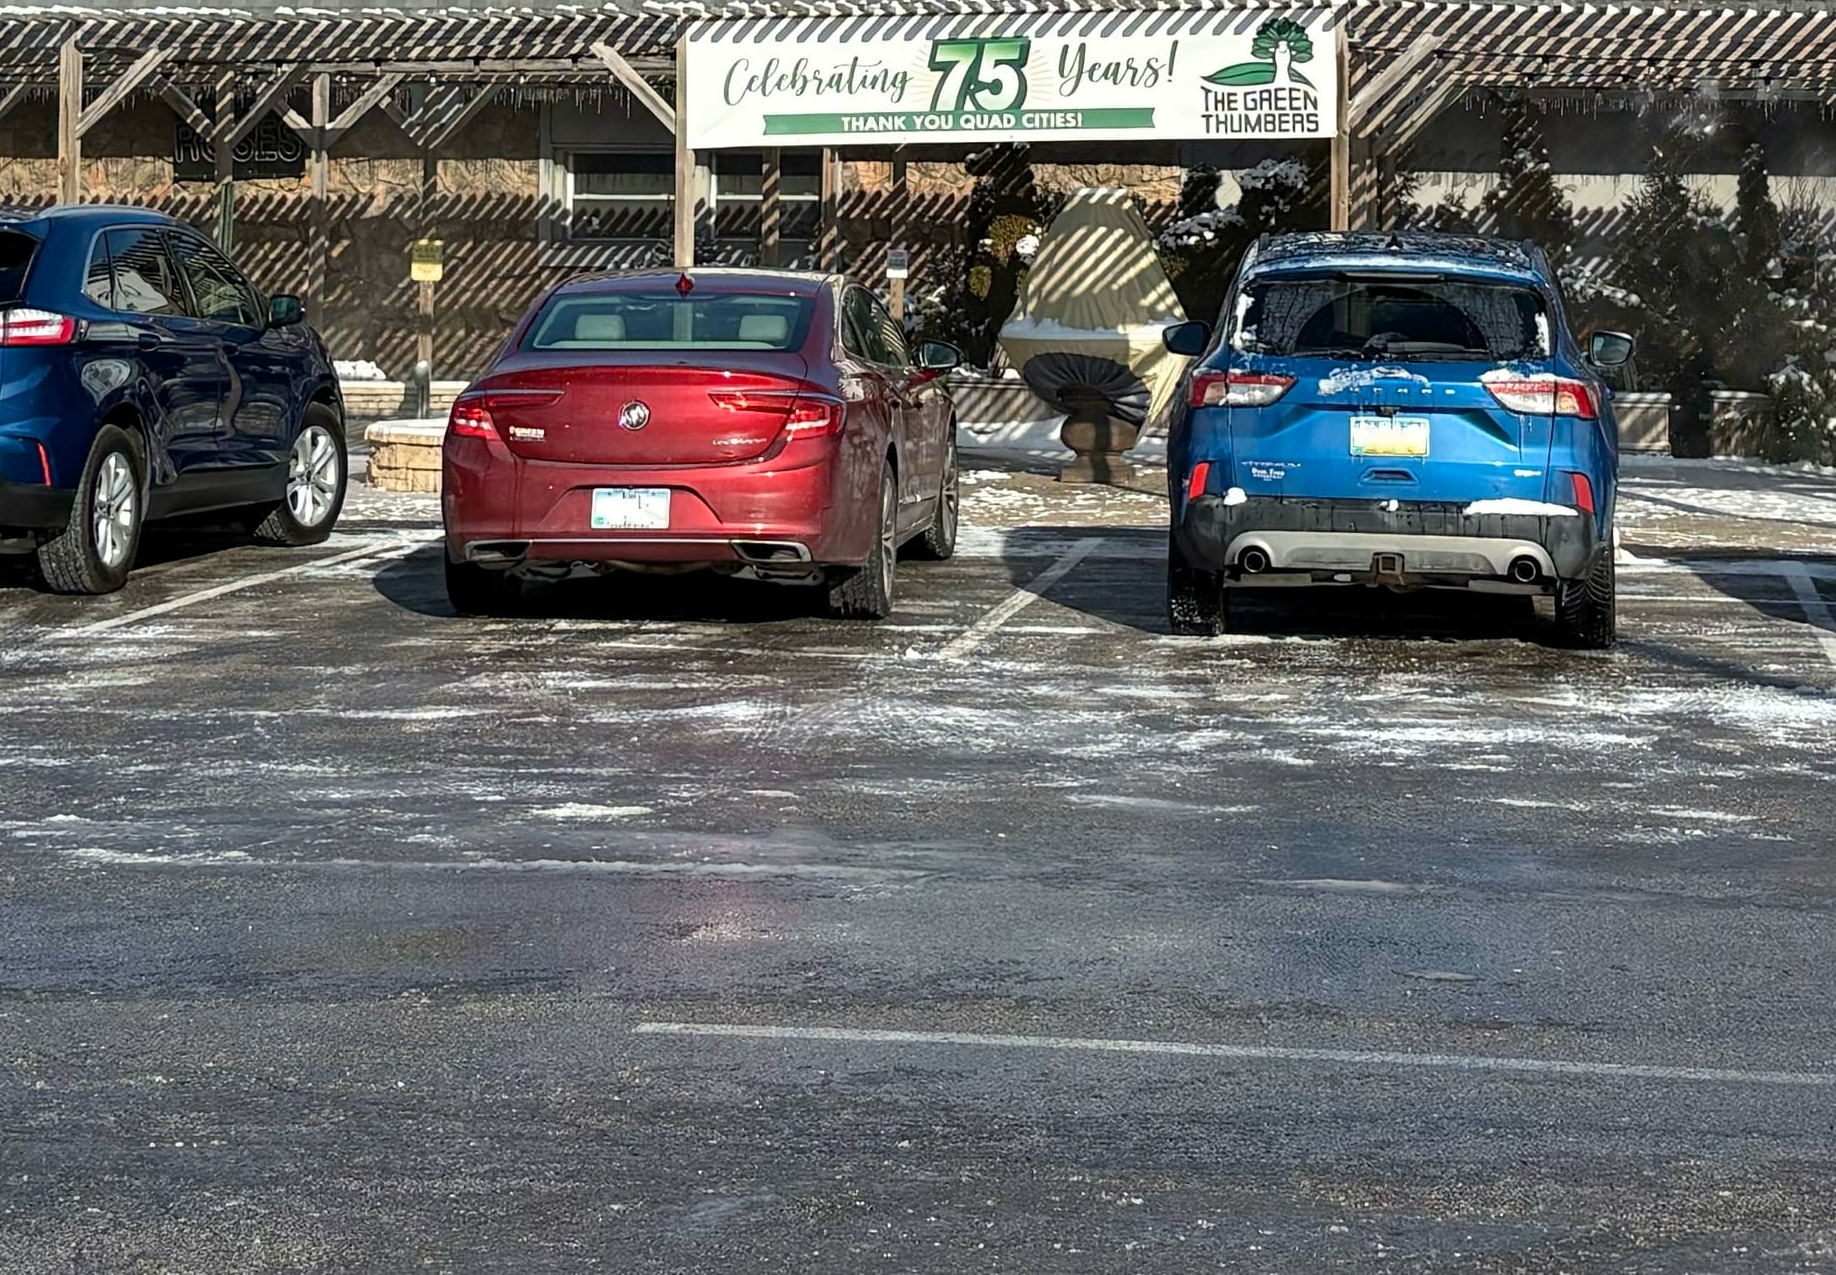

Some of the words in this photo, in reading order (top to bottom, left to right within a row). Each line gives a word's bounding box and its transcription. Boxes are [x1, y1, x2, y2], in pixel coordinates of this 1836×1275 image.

[723, 56, 914, 106] Celebrating
[928, 36, 1031, 111] 75
[1058, 39, 1178, 97] Years!
[1200, 86, 1238, 112] THE
[1244, 88, 1318, 112] GREEN
[841, 116, 906, 132] THANK
[913, 114, 953, 131] YOU
[959, 113, 1015, 131] QUAD
[1022, 111, 1082, 128] CITIES!
[1200, 113, 1319, 135] THUMBERS
